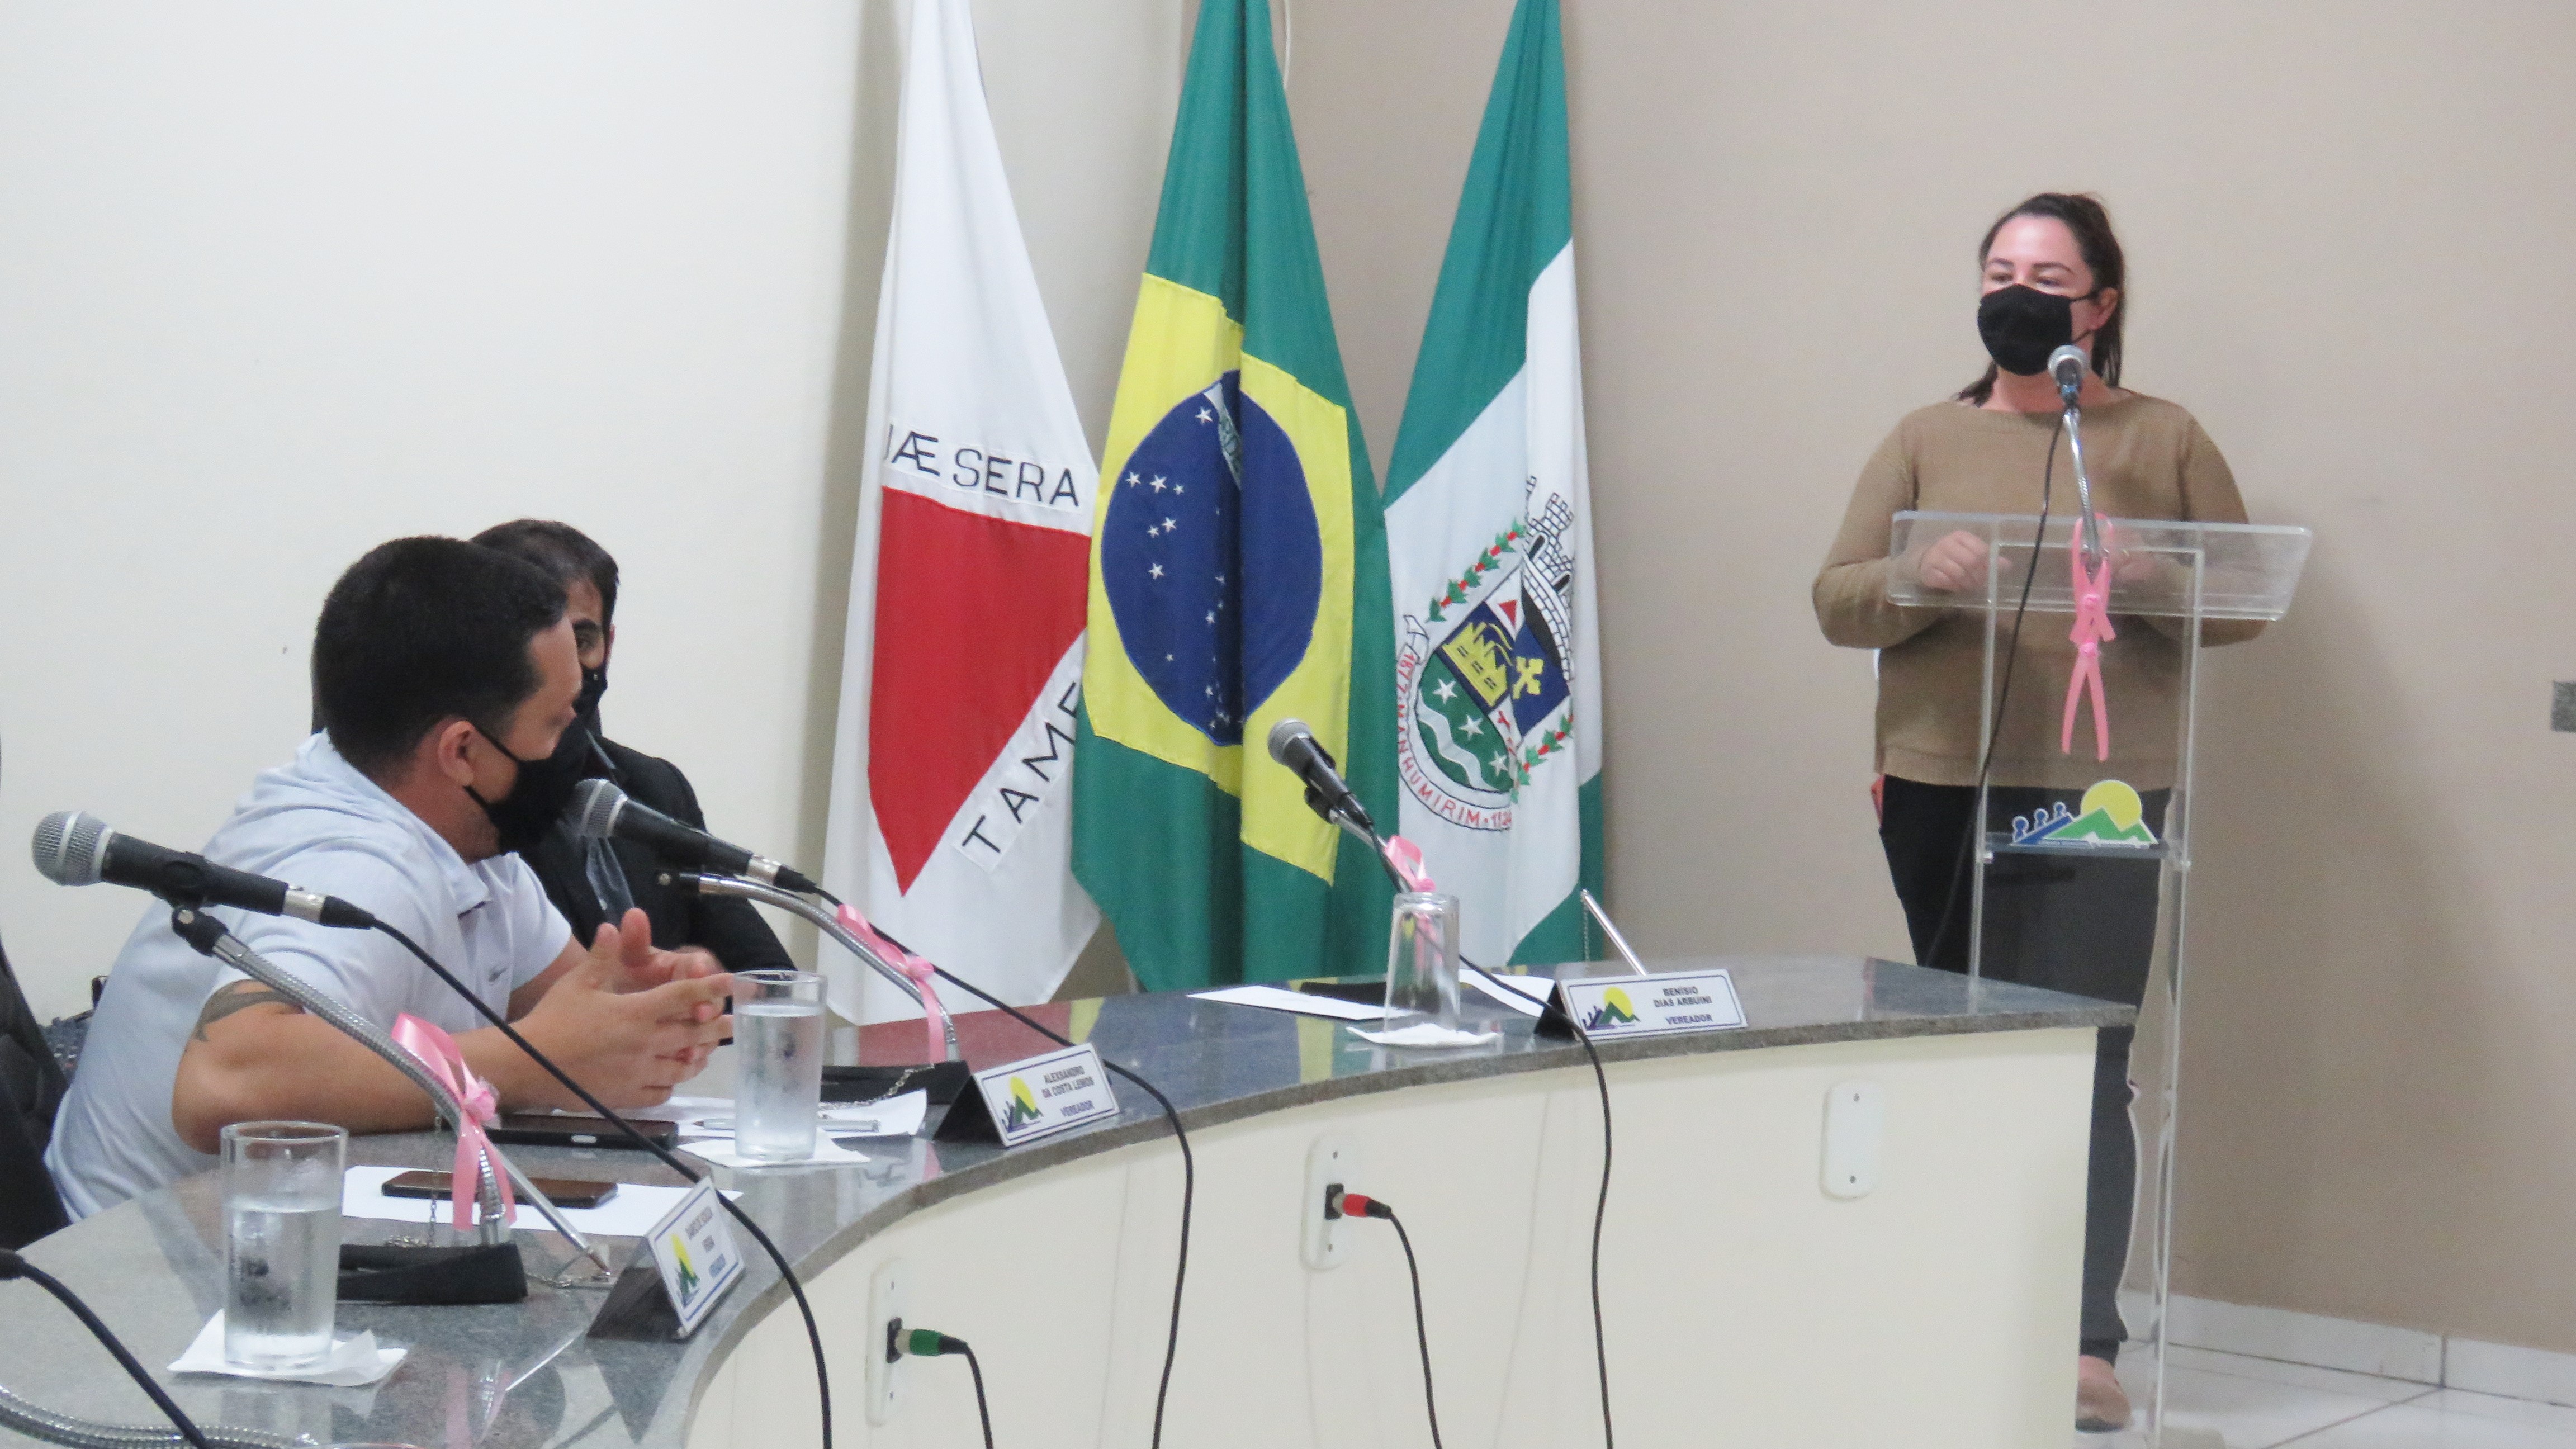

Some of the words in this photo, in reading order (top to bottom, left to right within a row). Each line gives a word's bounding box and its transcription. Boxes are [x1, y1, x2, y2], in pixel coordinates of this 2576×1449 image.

[952, 448, 1079, 507] SERA
[1654, 998, 1674, 1007] DIAS
[1666, 1014, 1712, 1024] VEREADOR
[1053, 1083, 1072, 1096] COSTA
[1061, 1101, 1094, 1116] VEREADOR
